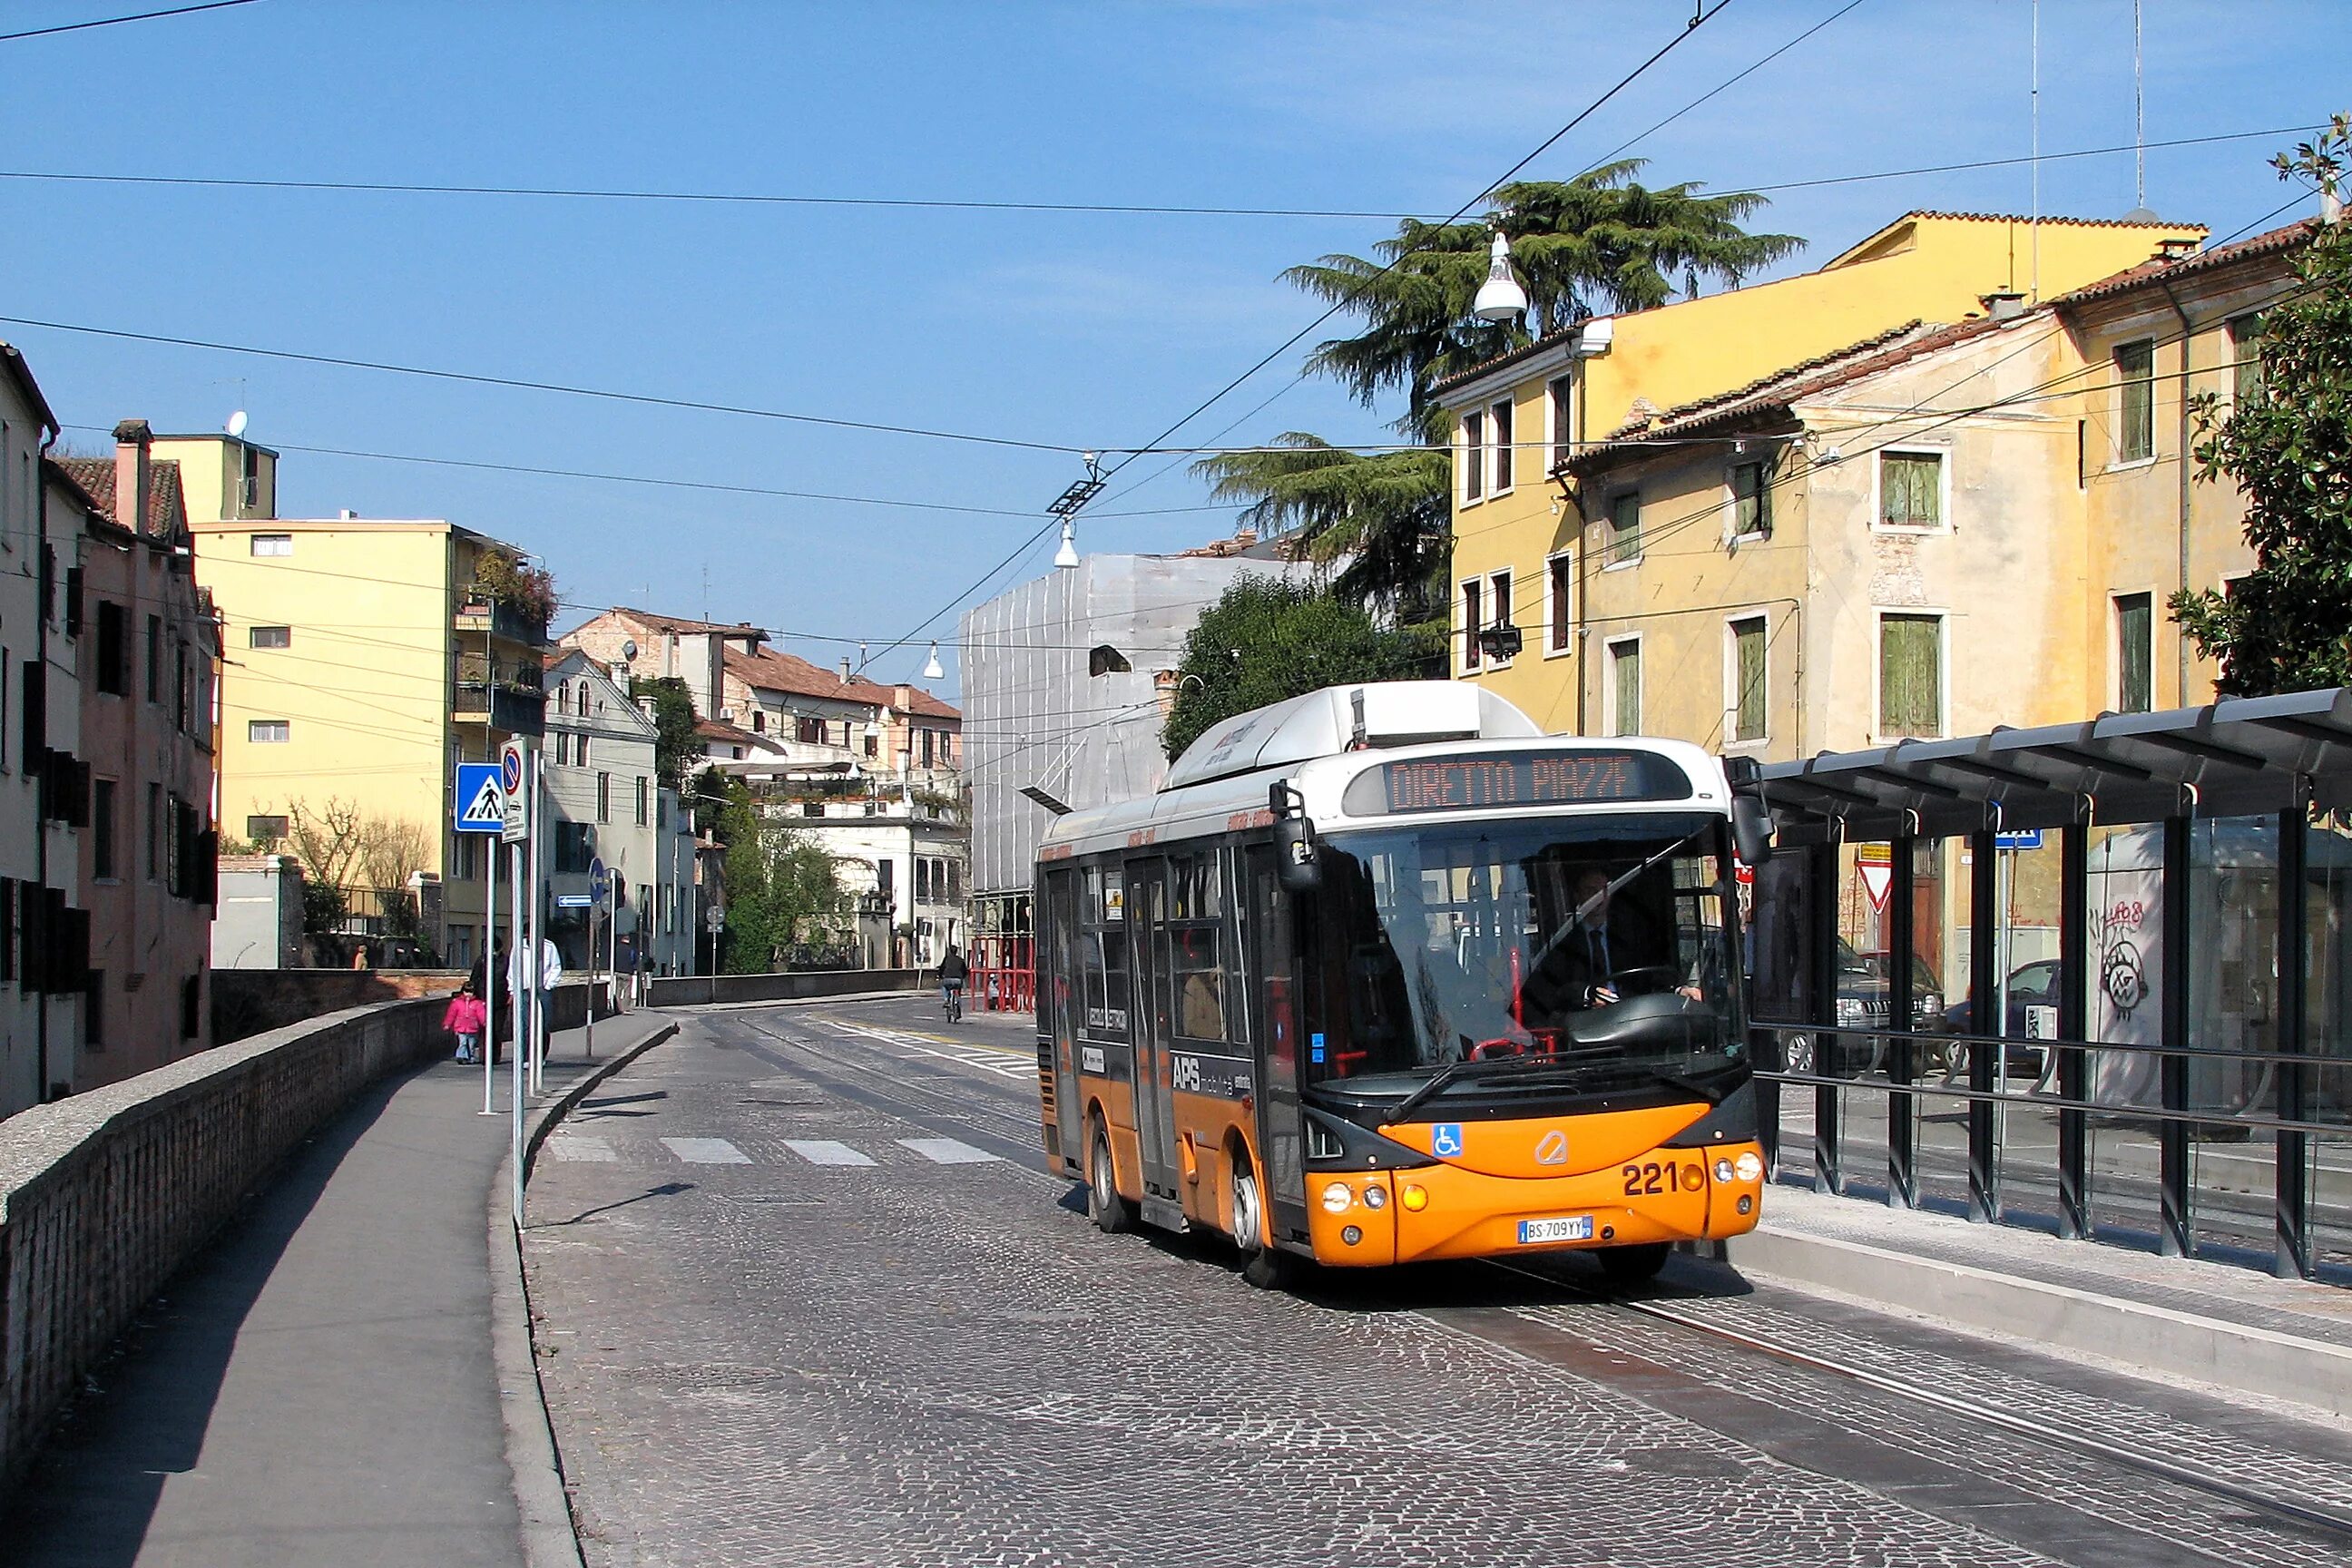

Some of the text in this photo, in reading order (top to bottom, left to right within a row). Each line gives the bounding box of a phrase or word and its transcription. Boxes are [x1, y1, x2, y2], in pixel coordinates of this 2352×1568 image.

[1392, 760, 1515, 808] DIRETTO
[1173, 1056, 1200, 1092] APS
[1622, 1161, 1677, 1196] 221
